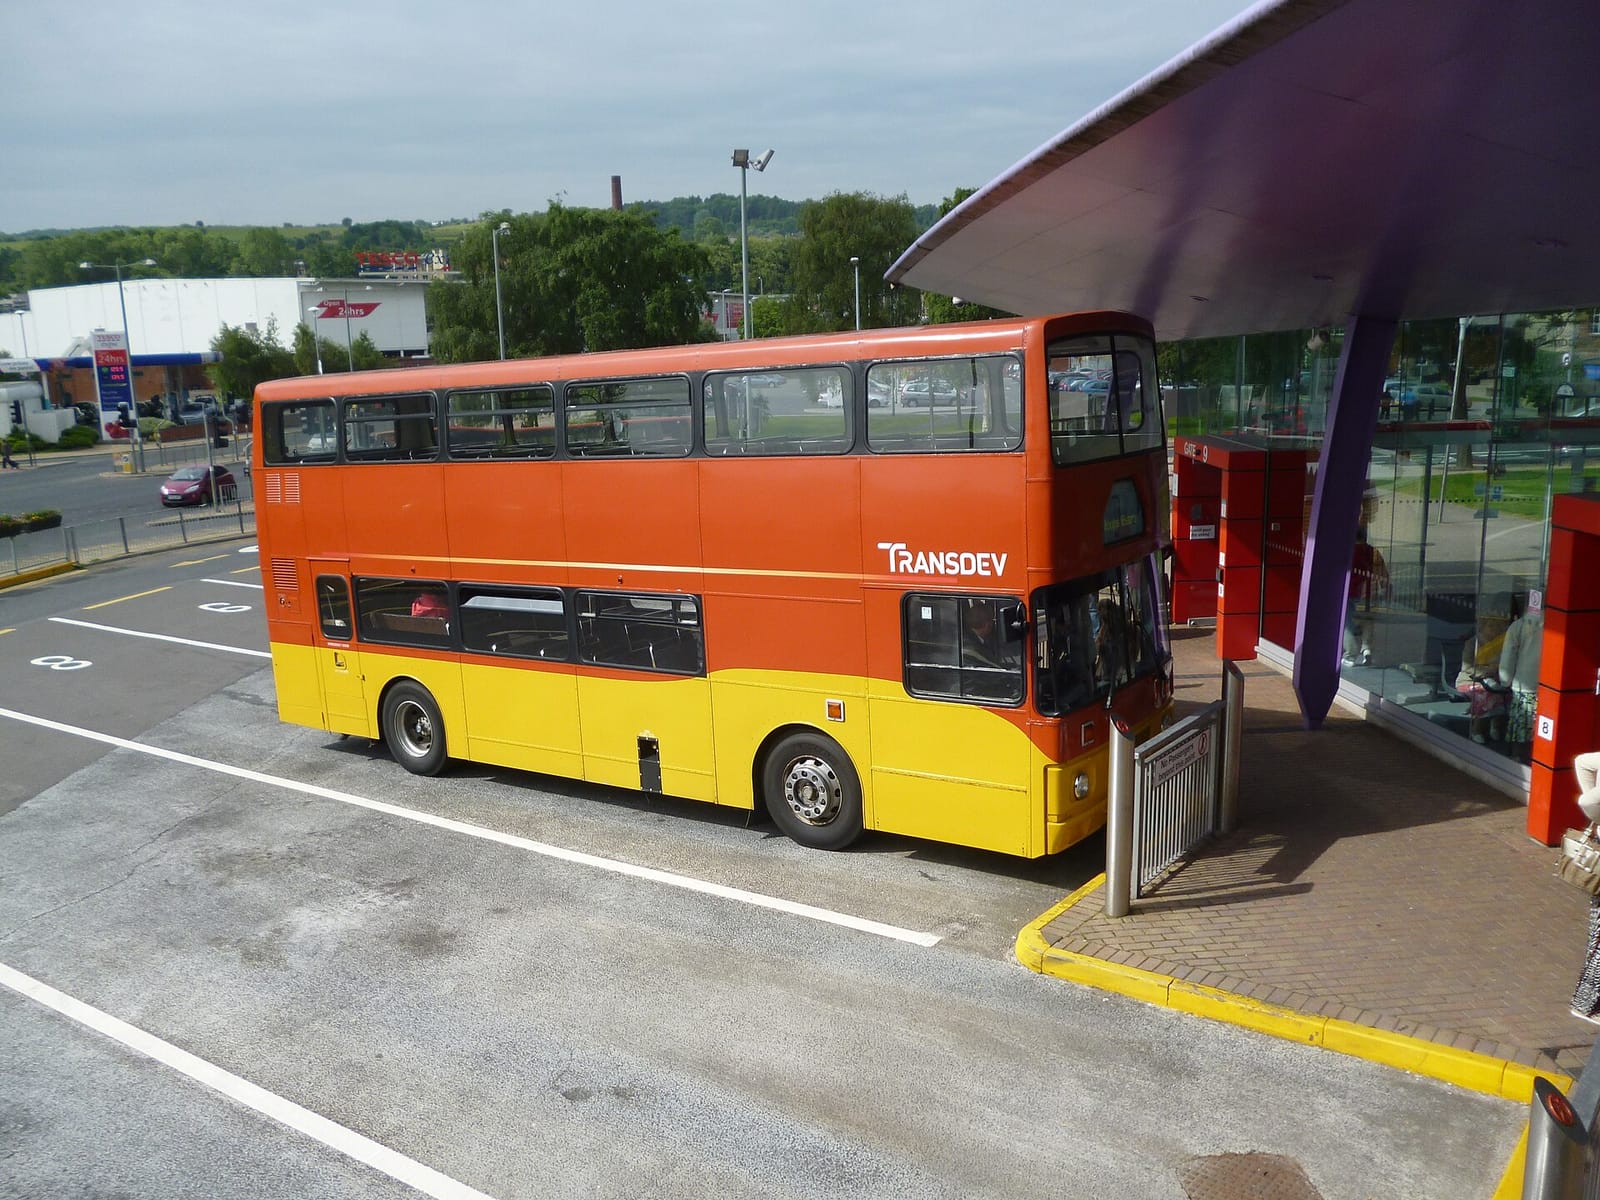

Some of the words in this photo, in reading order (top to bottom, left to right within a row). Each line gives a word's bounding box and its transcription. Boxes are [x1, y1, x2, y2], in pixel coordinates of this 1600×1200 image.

[355, 253, 418, 266] TESCO
[1202, 444, 1208, 463] 9
[877, 542, 1008, 577] TRANSDEV
[30, 655, 93, 670] 8
[1542, 721, 1549, 734] 8
